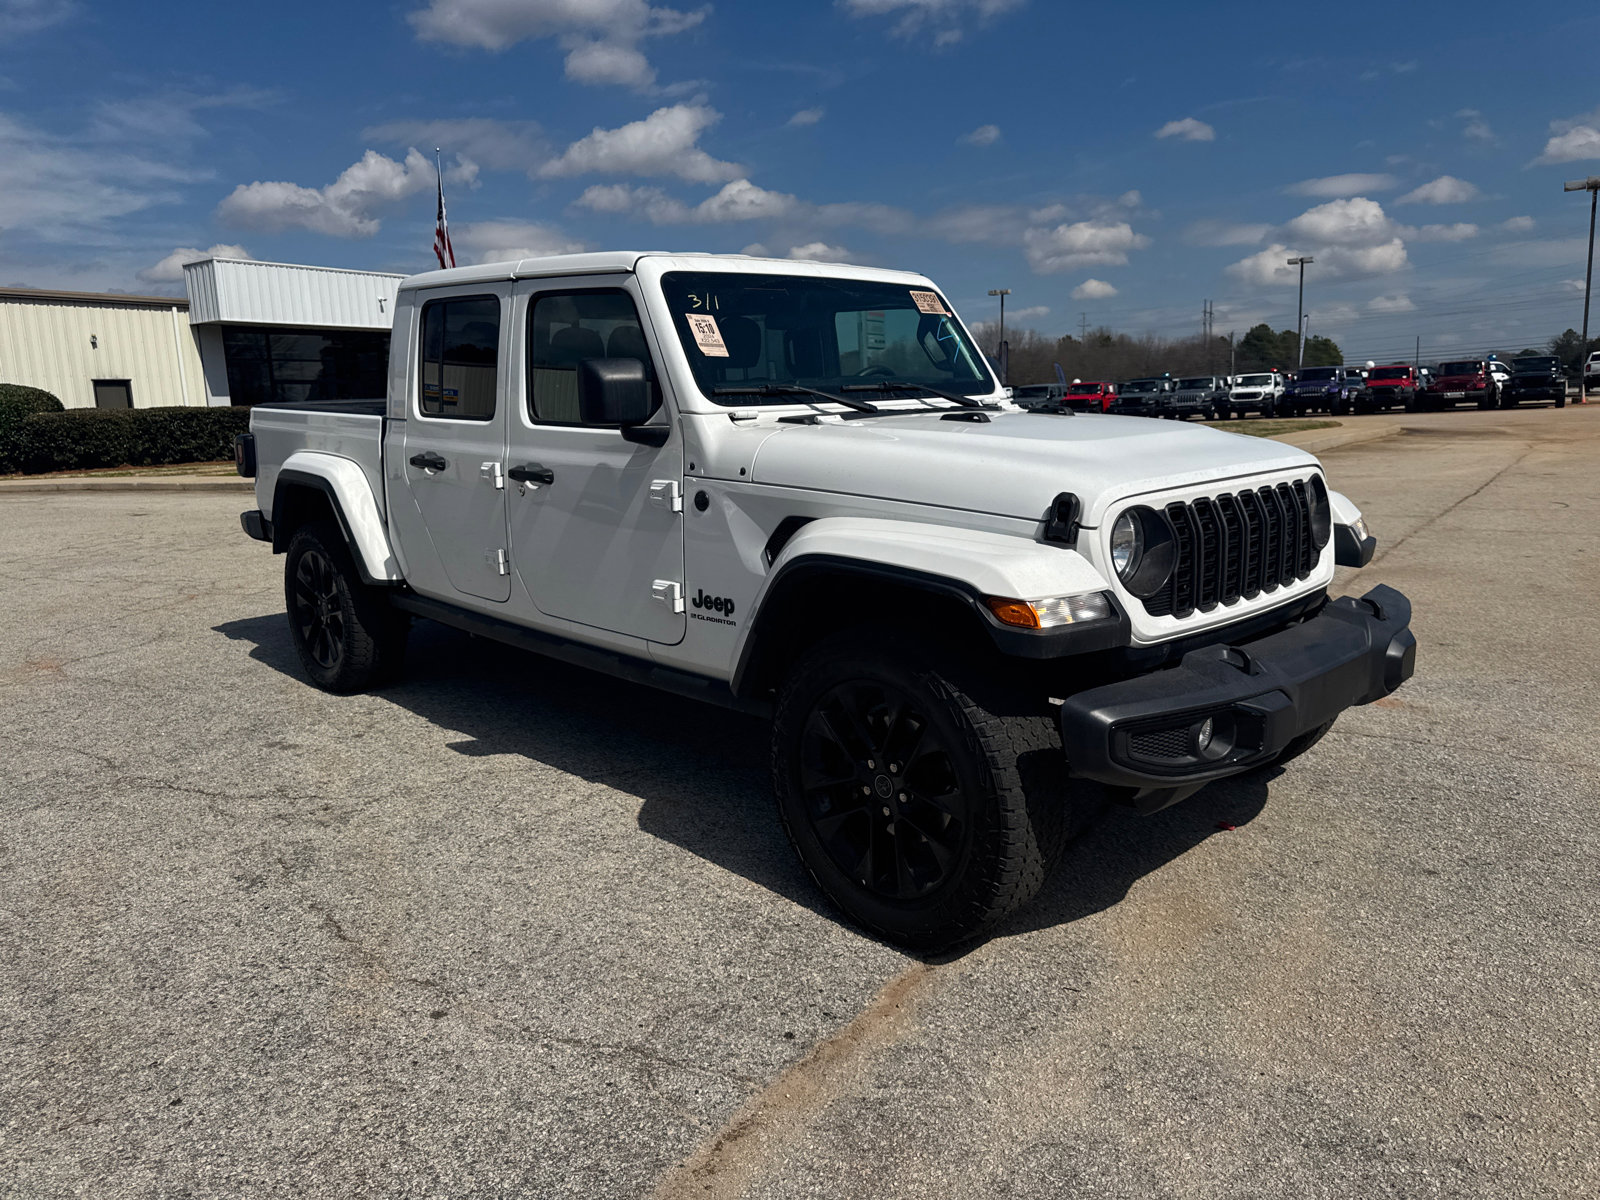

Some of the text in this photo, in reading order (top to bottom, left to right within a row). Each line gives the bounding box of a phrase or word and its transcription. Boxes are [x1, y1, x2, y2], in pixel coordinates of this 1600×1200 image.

[695, 322, 715, 335] 15:10
[692, 589, 735, 617] Jeep
[697, 614, 736, 627] GLADIATOR
